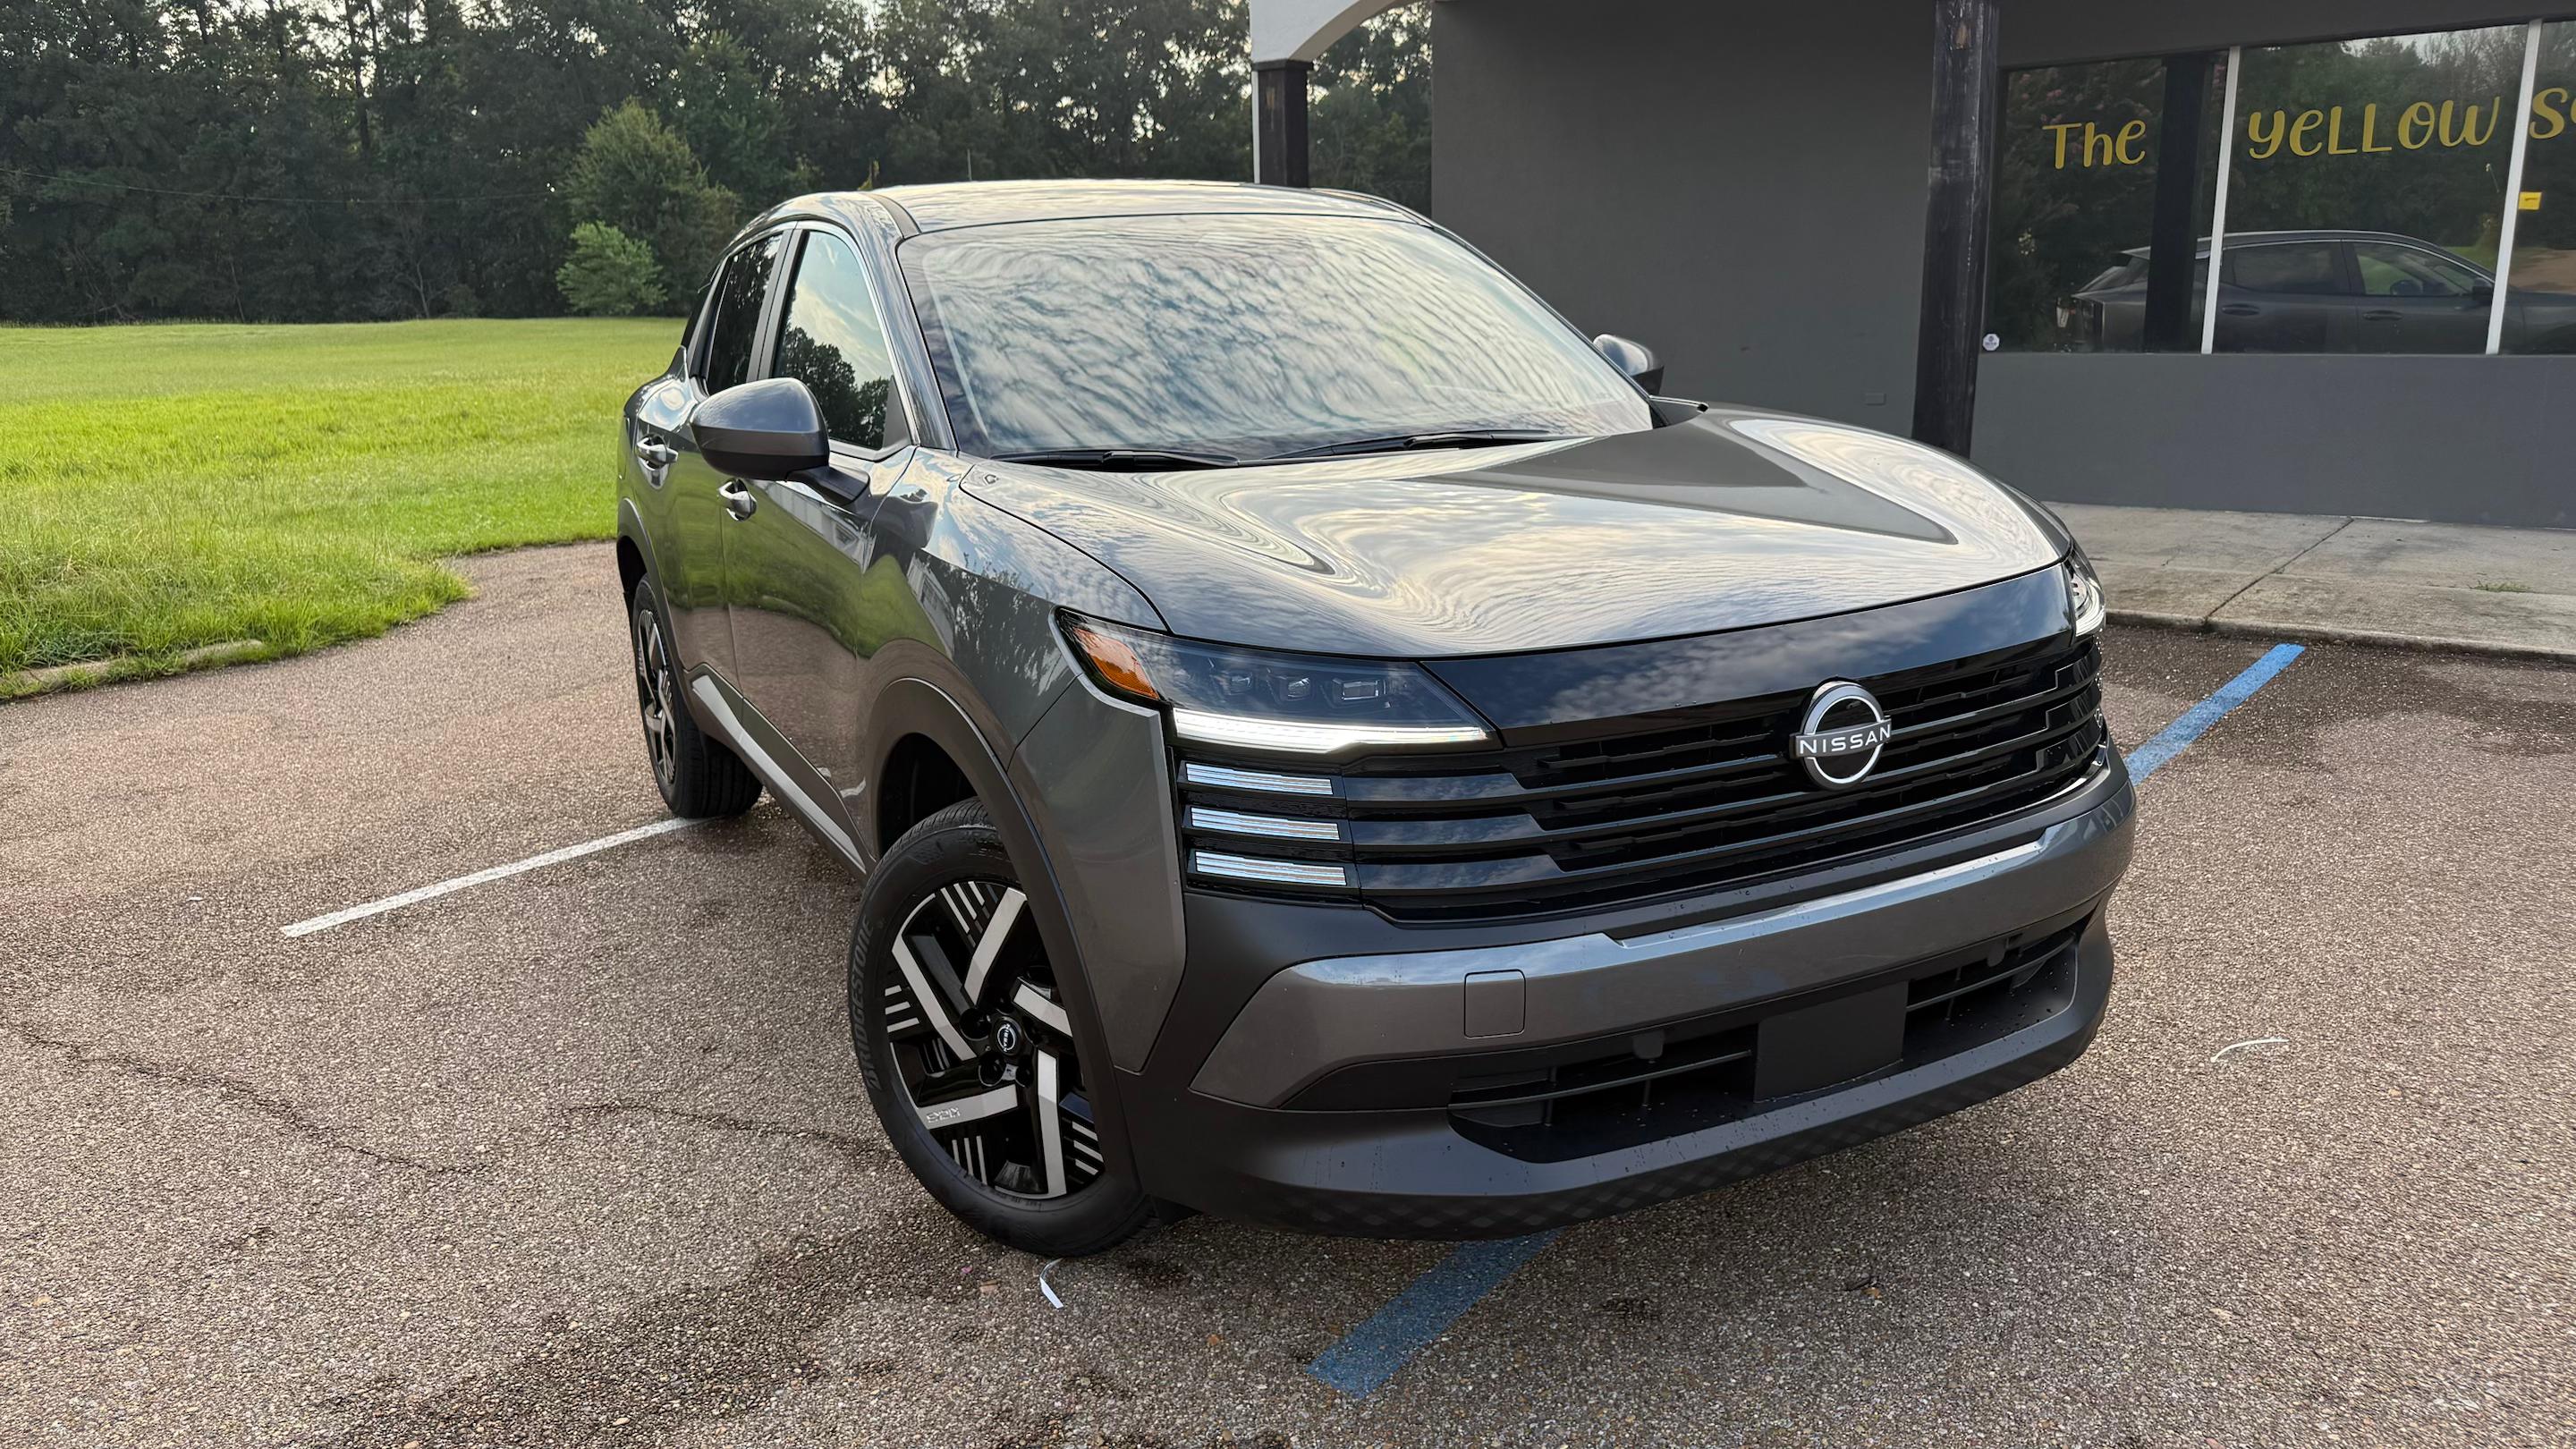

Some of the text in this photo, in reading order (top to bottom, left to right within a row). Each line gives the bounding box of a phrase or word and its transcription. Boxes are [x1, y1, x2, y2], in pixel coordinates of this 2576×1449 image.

[2042, 119, 2146, 170] The
[2529, 87, 2576, 140] S
[1799, 724, 1891, 754] NISSAN
[852, 914, 883, 1091] BRIDGESTONE
